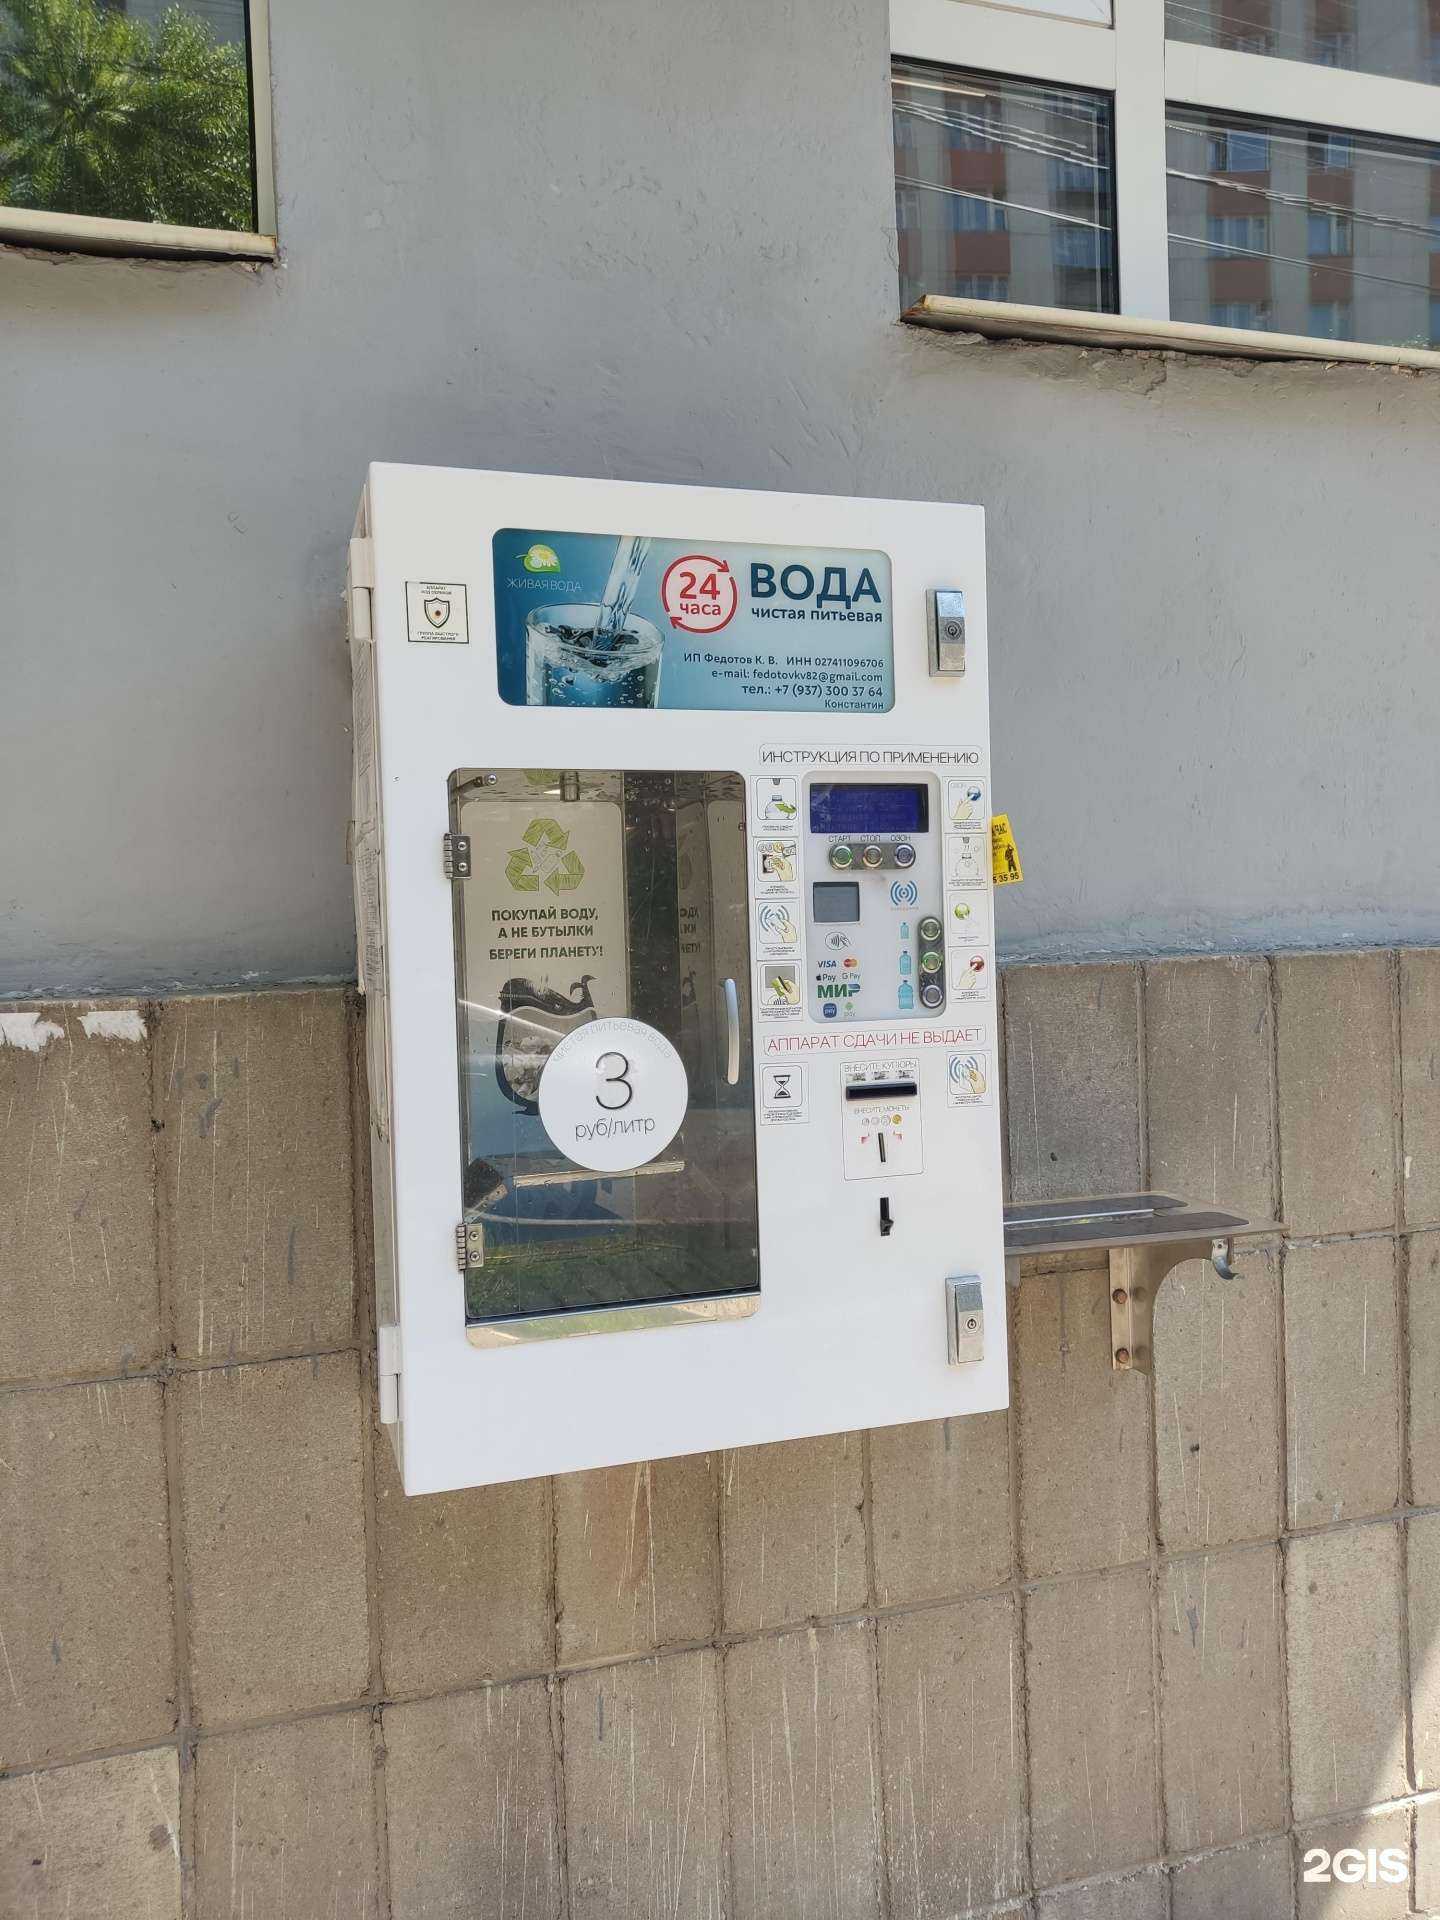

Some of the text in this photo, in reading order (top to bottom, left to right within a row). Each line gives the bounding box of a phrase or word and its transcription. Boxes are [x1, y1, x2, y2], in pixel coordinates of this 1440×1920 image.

[506, 577, 584, 592] ЖИВАЯ ВОДА
[679, 571, 721, 600] 24
[750, 562, 882, 609] ВОДА
[679, 602, 722, 616] часа
[751, 607, 884, 623] чистая питьевая
[684, 653, 884, 668] ИП Федотов К. В. ИНН 027411096706
[711, 669, 884, 683] e-mail: fedotovkv82@gmail.com
[742, 685, 883, 698] тел.: +7 (937) 300 37 64
[824, 699, 884, 710] Константин
[762, 750, 979, 764] ИНСТРУКЦИЯ ПО ПРИМЕНЕНИЮ
[491, 906, 599, 920] ПОКУПАЙ ВОДУ,
[497, 925, 593, 938] А НЕ БУТЫЛКИ
[489, 945, 604, 960] БЕРЕГИ ПЛАНЕТУ!
[817, 960, 837, 968] VISA
[817, 983, 861, 998] МИР
[767, 1028, 982, 1052] АППАРАТ СДАЧИ НЕ ВЫДАЕТ
[596, 1051, 633, 1110] 3
[575, 1117, 656, 1142] руб/литр
